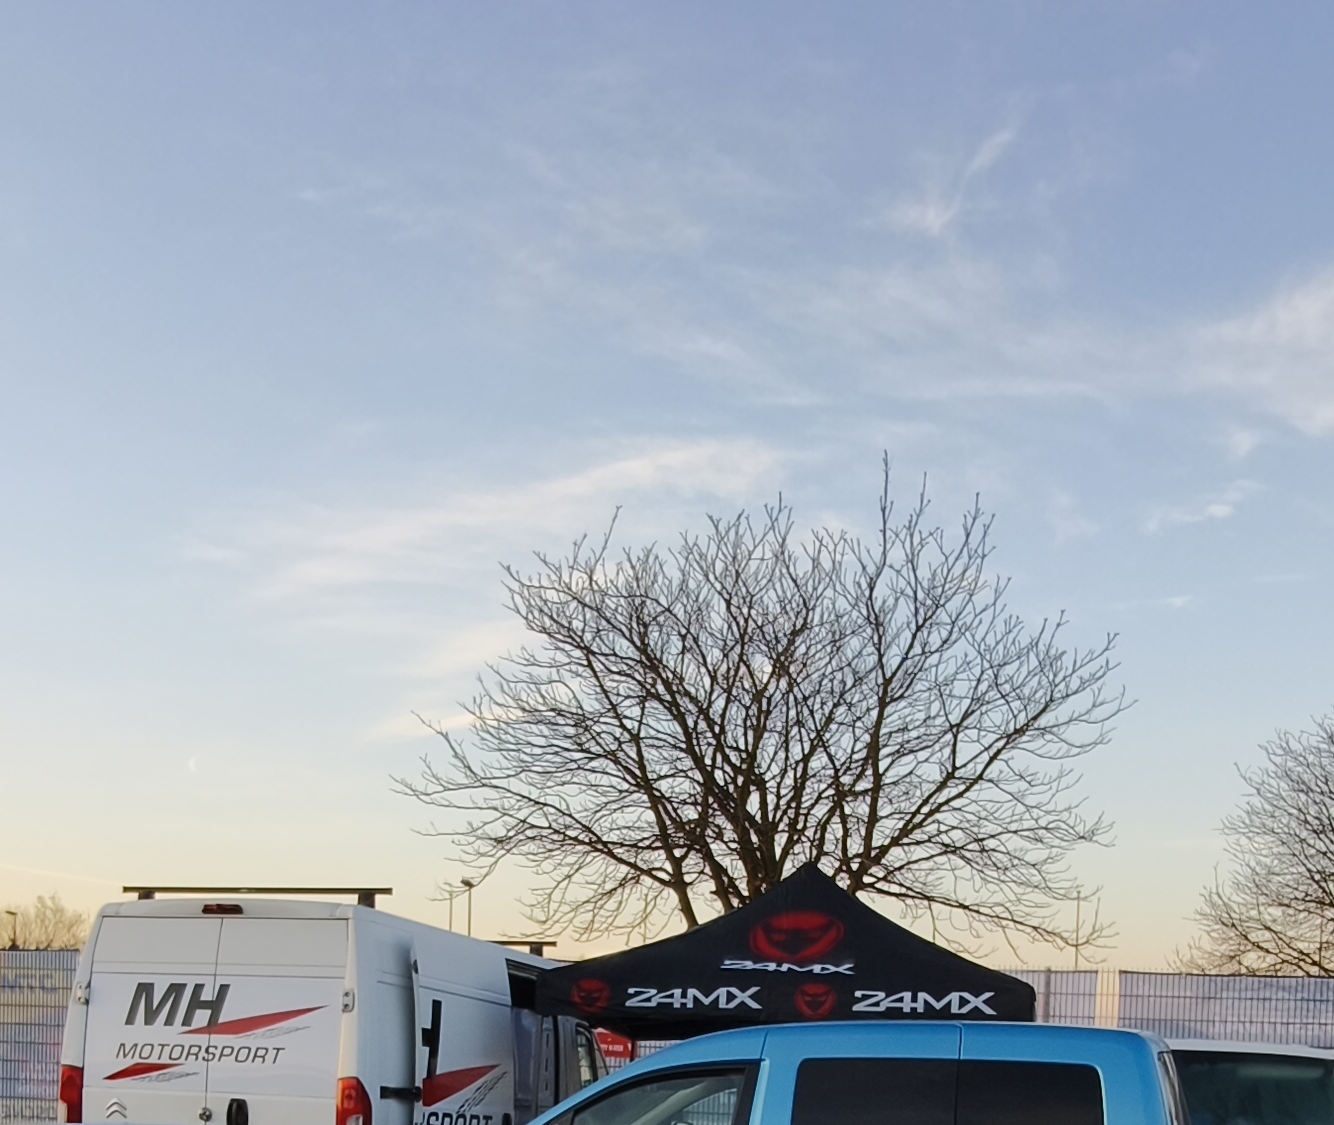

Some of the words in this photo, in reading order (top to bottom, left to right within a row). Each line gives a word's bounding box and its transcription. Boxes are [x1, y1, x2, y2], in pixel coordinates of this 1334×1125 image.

[720, 959, 855, 975] 24MX
[124, 982, 231, 1028] MH
[625, 986, 763, 1011] 24MX
[852, 990, 998, 1015] 24MX
[116, 1043, 285, 1064] MOTORSPORT
